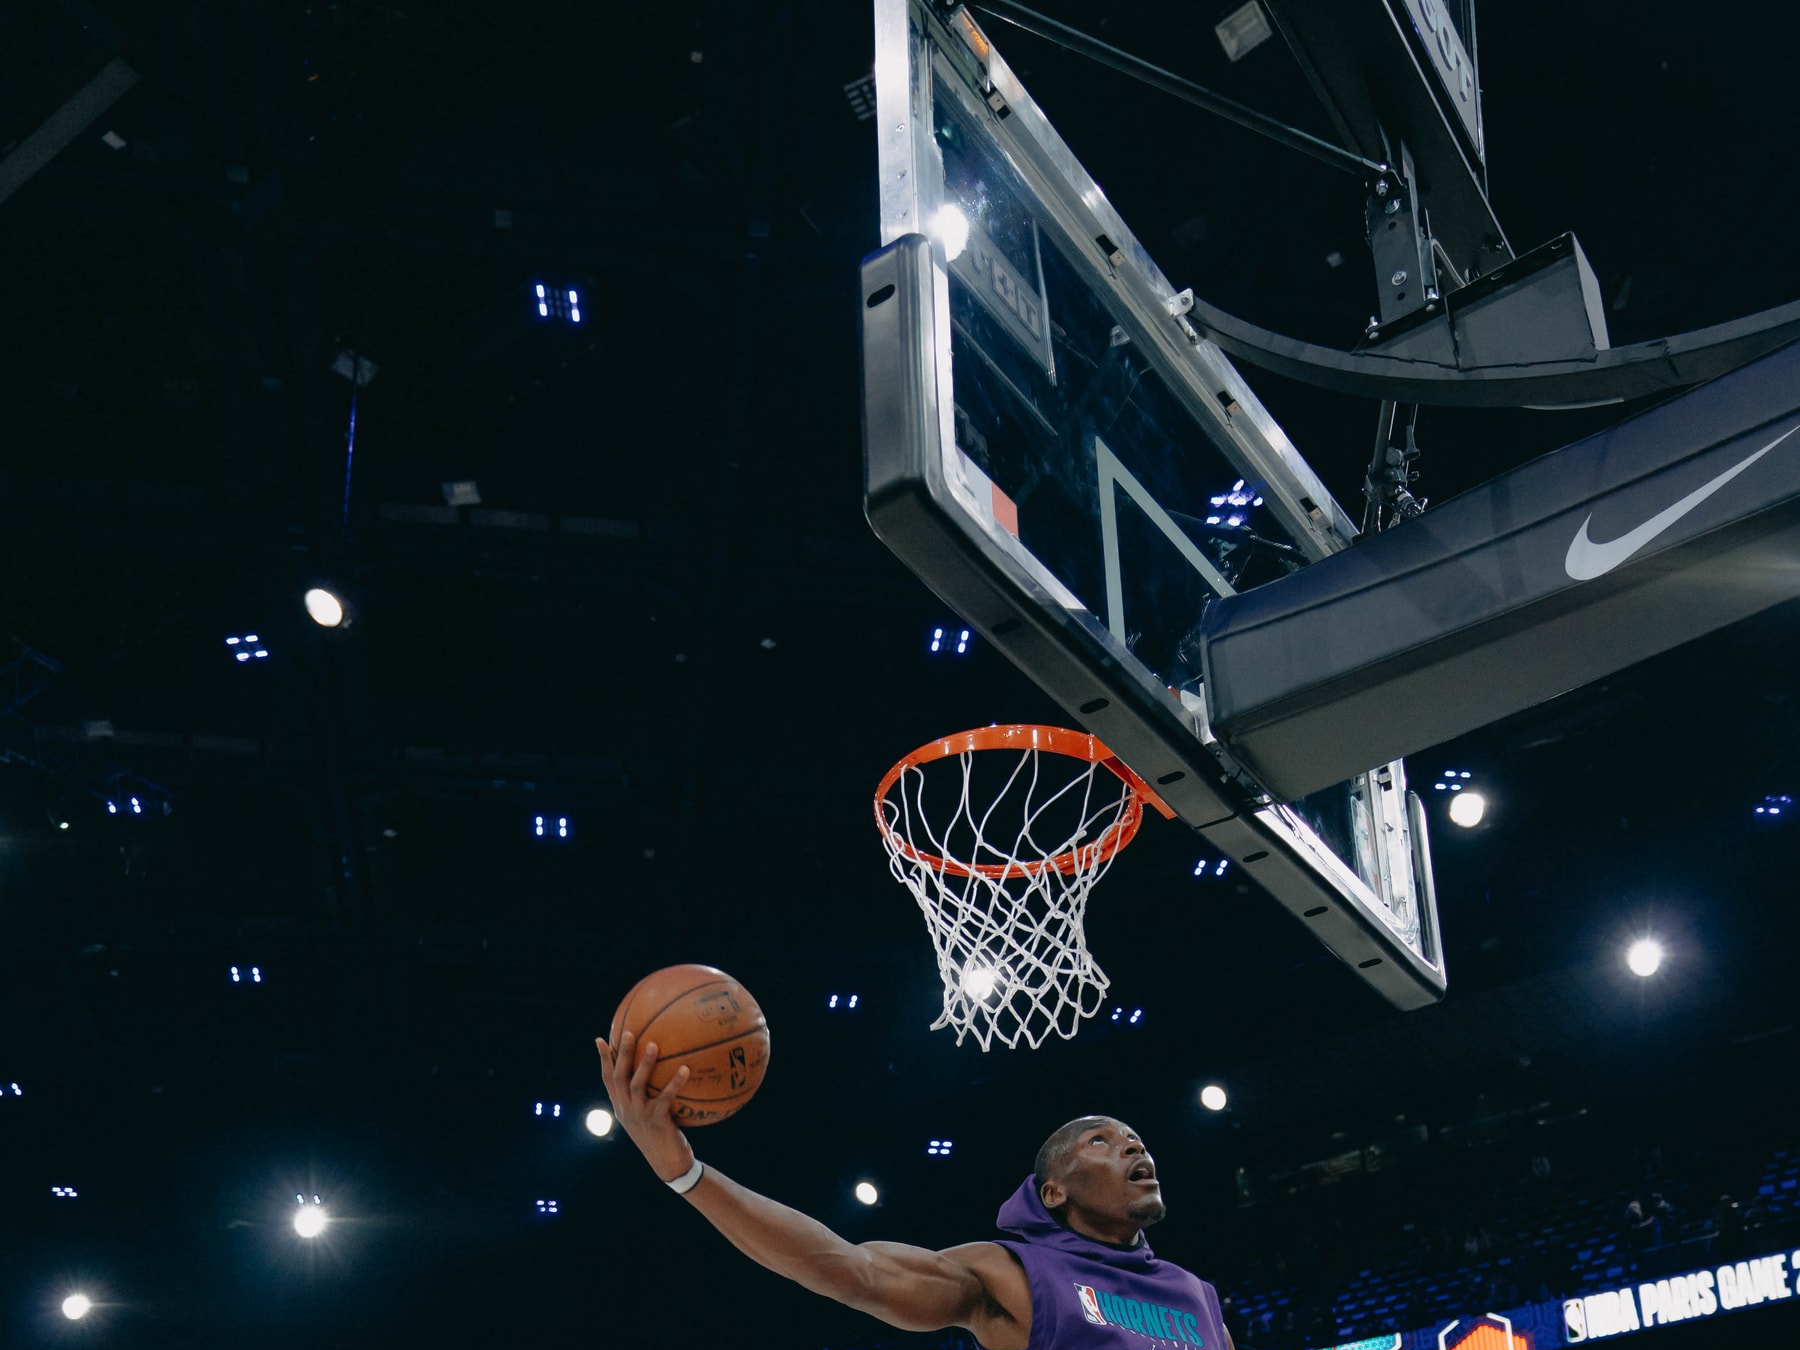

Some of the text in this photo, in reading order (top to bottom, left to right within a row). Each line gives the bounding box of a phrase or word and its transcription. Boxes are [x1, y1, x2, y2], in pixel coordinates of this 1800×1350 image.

[1095, 1289, 1204, 1347] HORNETS
[1584, 1288, 1640, 1339] NBA
[1639, 1270, 1718, 1328] PARIS
[1716, 1253, 1793, 1310] GAME
